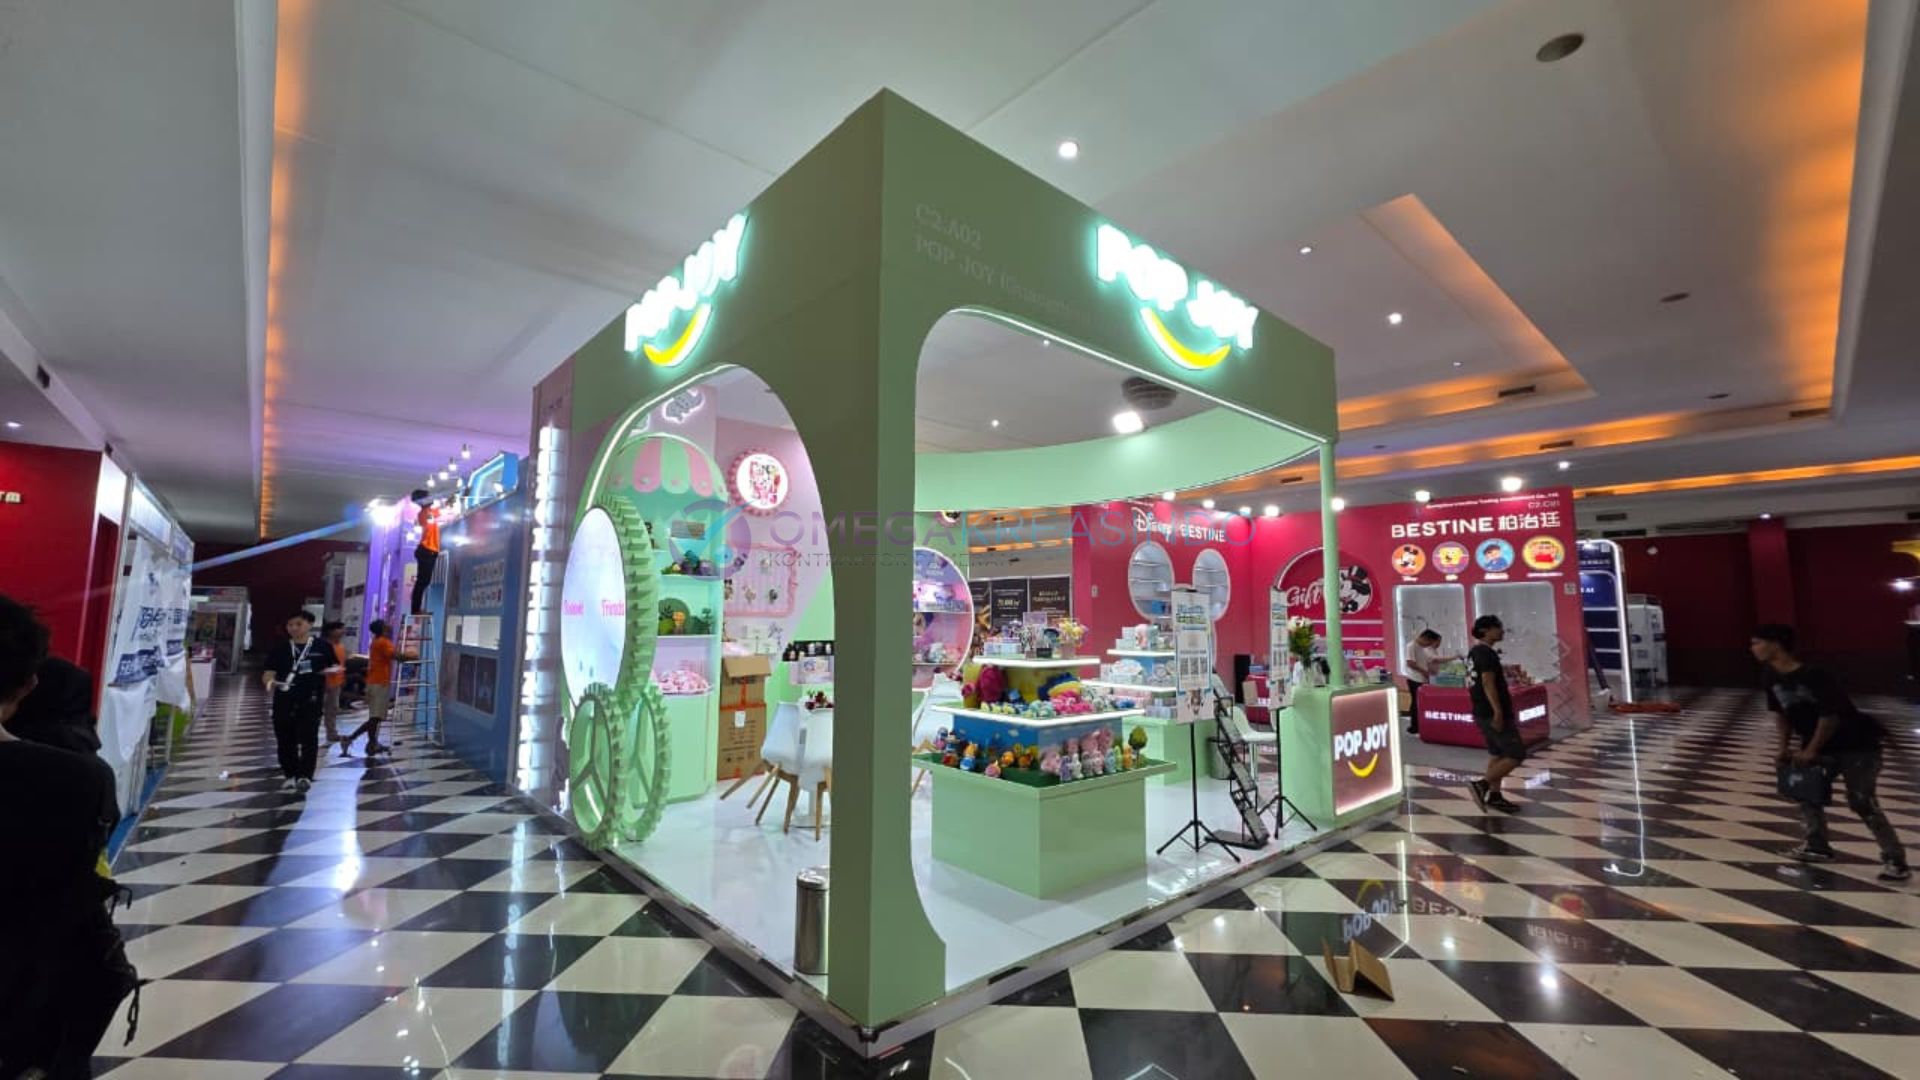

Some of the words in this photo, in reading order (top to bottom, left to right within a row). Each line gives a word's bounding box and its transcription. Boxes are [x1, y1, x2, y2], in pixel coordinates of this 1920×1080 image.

[1097, 224, 1189, 312] POP
[1186, 279, 1259, 350] JOY
[1391, 517, 1494, 538] BESTINE
[1424, 710, 1475, 722] BESTINE
[1334, 730, 1362, 761] POP
[1363, 722, 1388, 752] JOY
